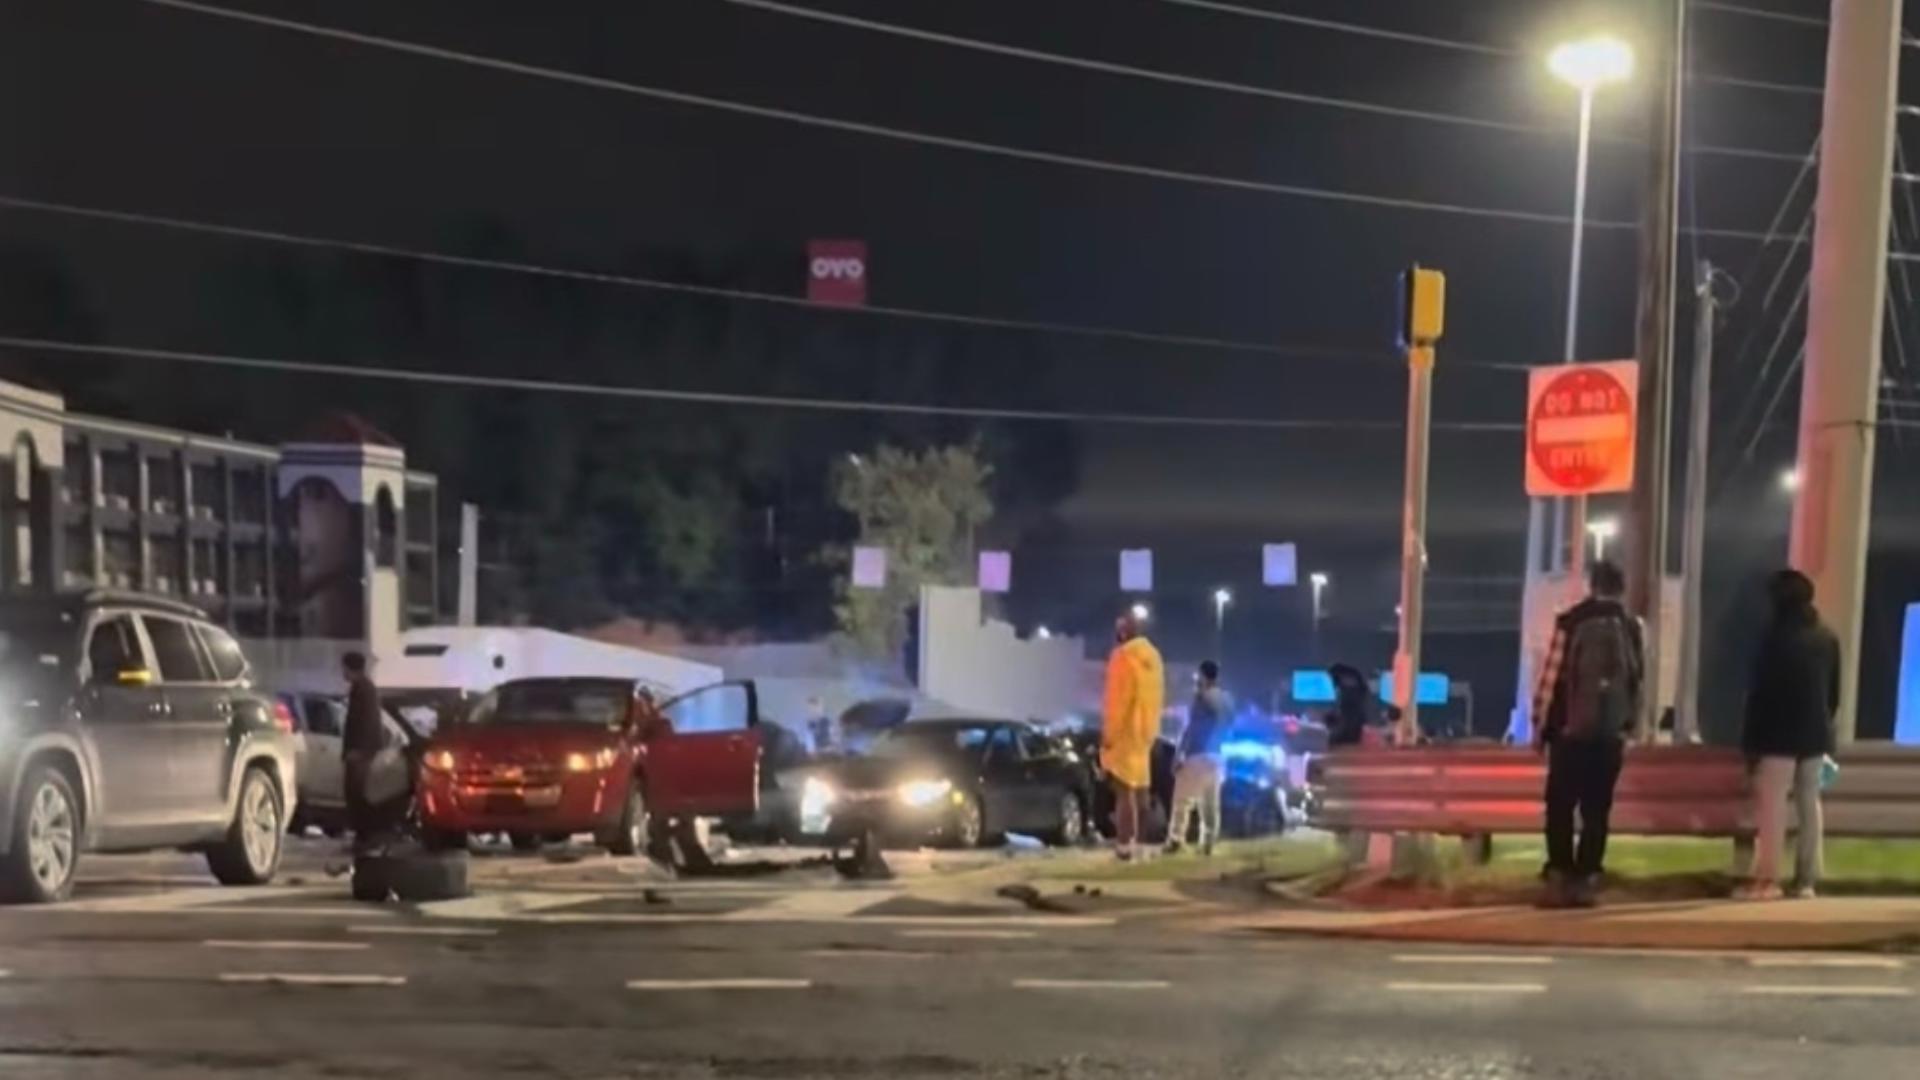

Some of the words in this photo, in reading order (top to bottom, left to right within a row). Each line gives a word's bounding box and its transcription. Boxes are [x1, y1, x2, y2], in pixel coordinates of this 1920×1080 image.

[811, 257, 864, 279] OYO
[1545, 391, 1572, 414] DO
[1580, 387, 1619, 410] NOT
[1549, 447, 1611, 469] ENT
